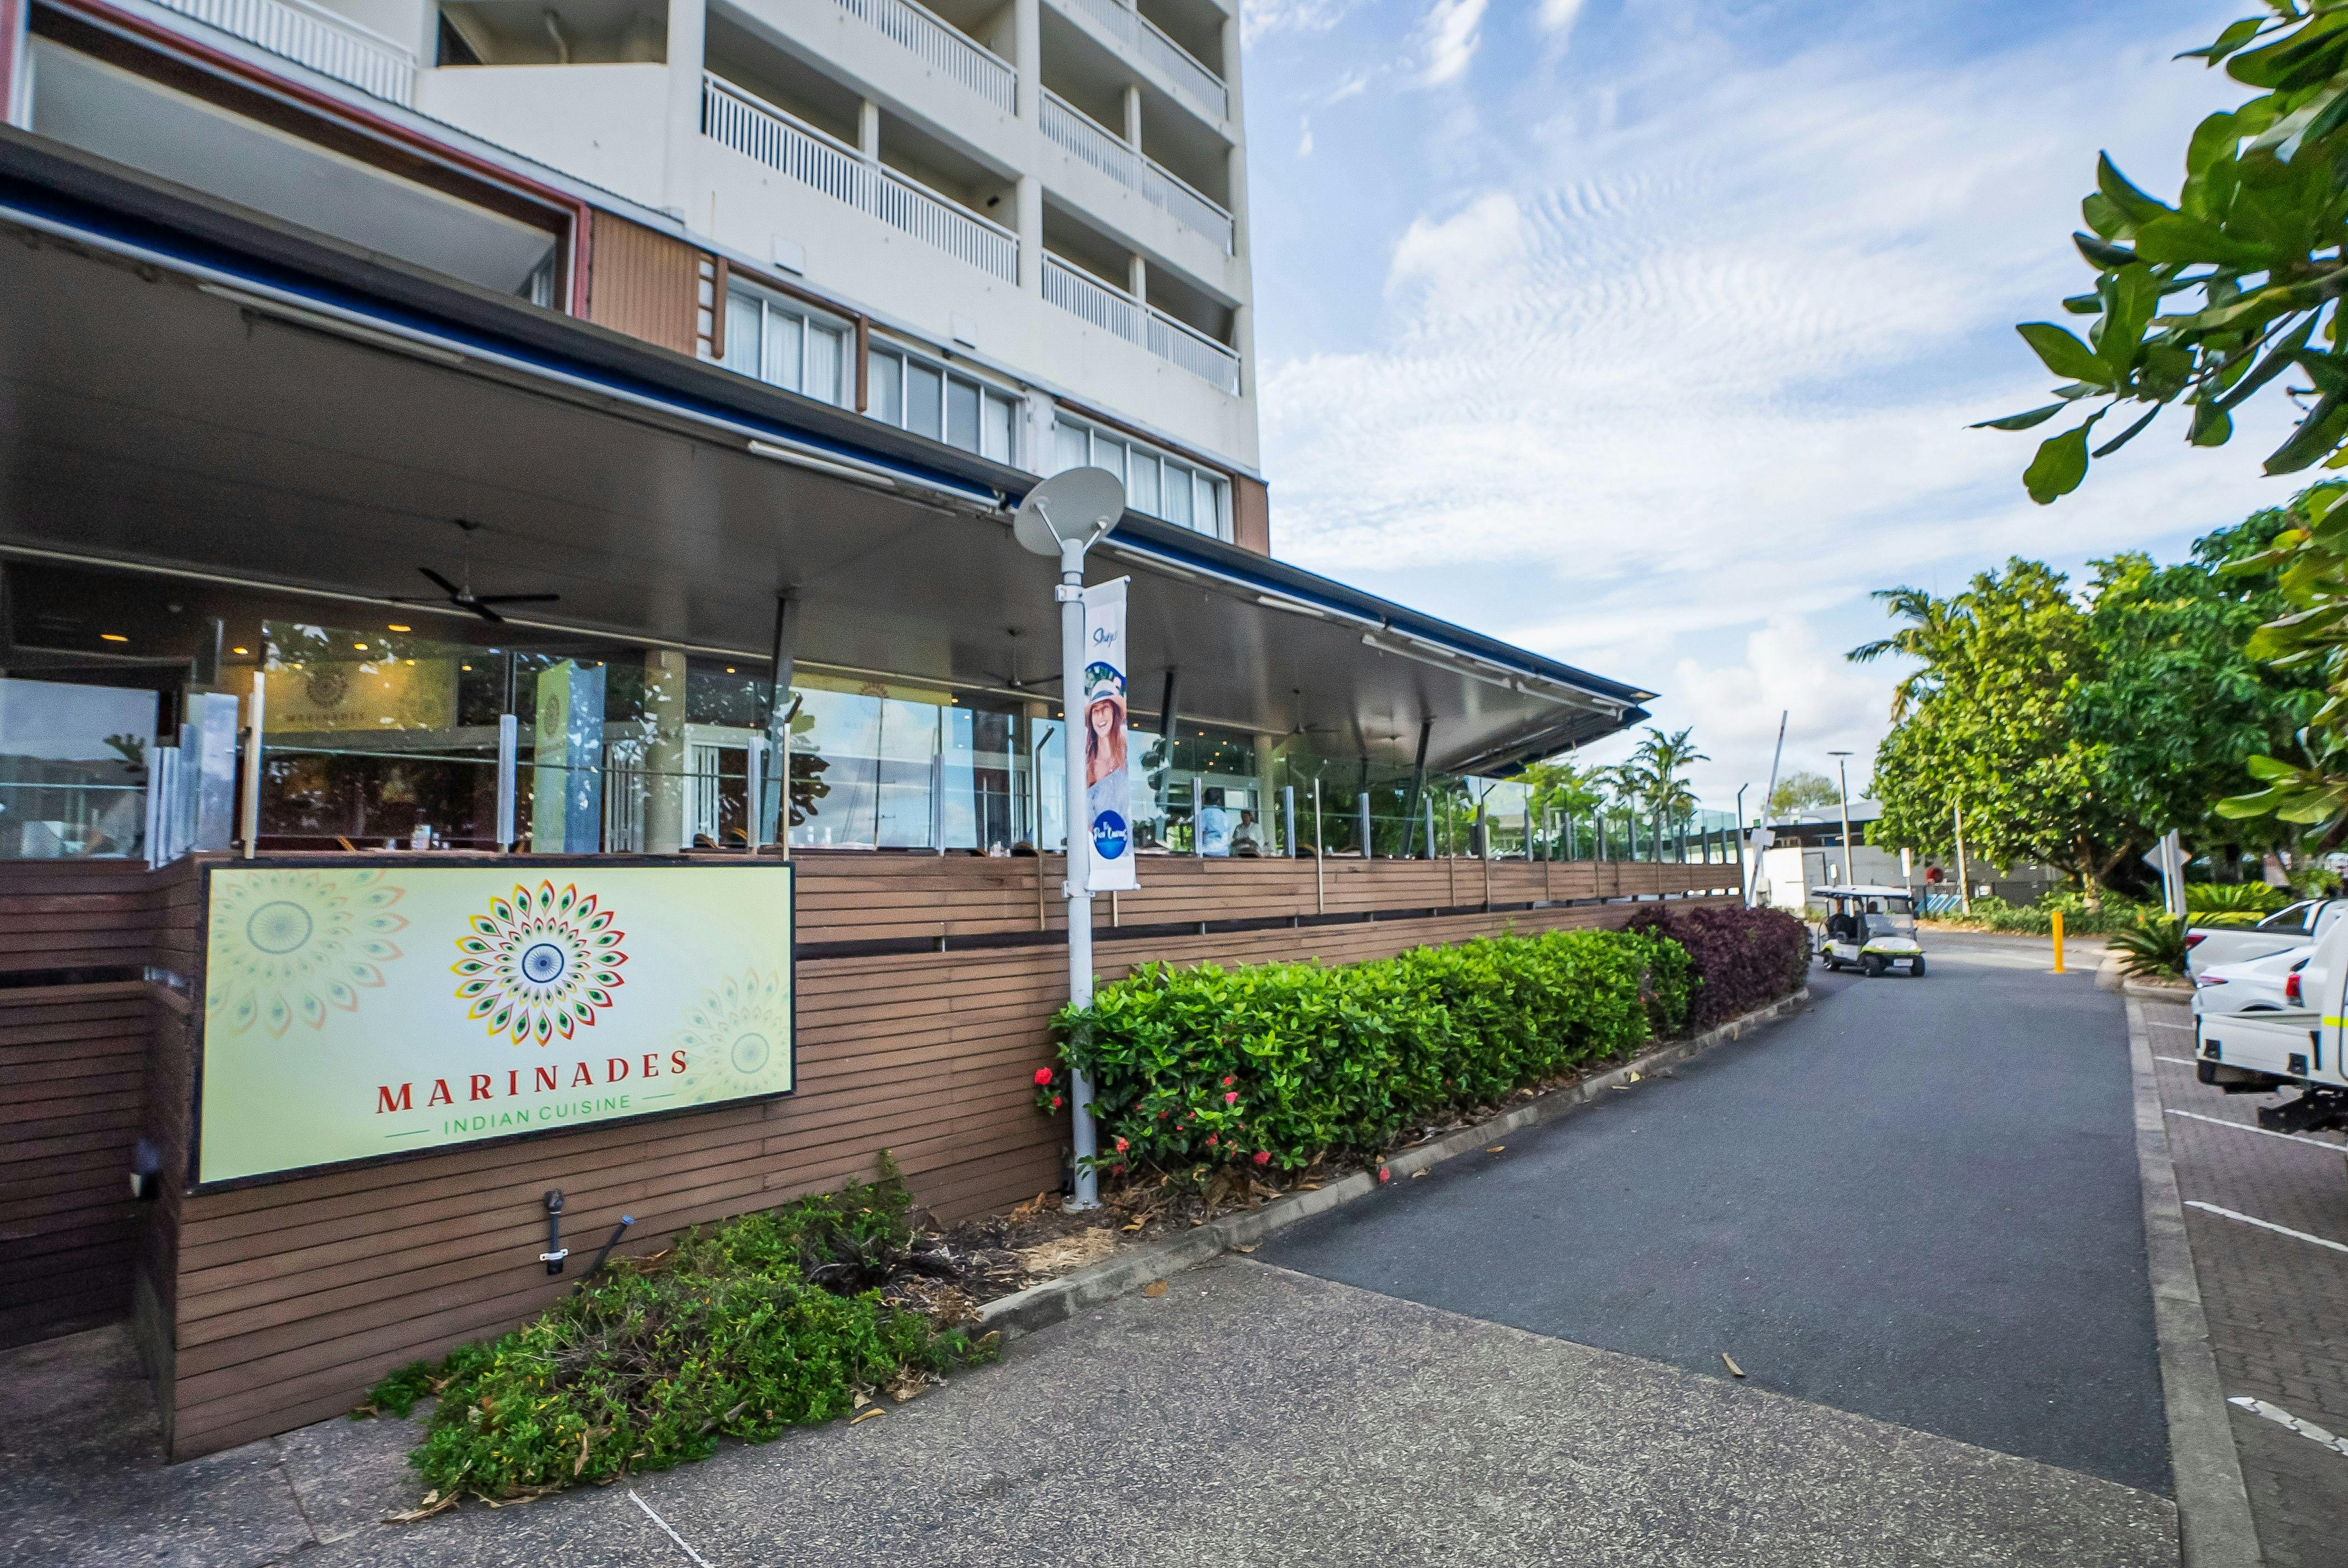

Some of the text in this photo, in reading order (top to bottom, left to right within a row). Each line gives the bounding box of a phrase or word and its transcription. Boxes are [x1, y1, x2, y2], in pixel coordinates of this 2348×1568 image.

[375, 1050, 687, 1113] MARINADES
[444, 1095, 630, 1135] INDIAN CUISINE
